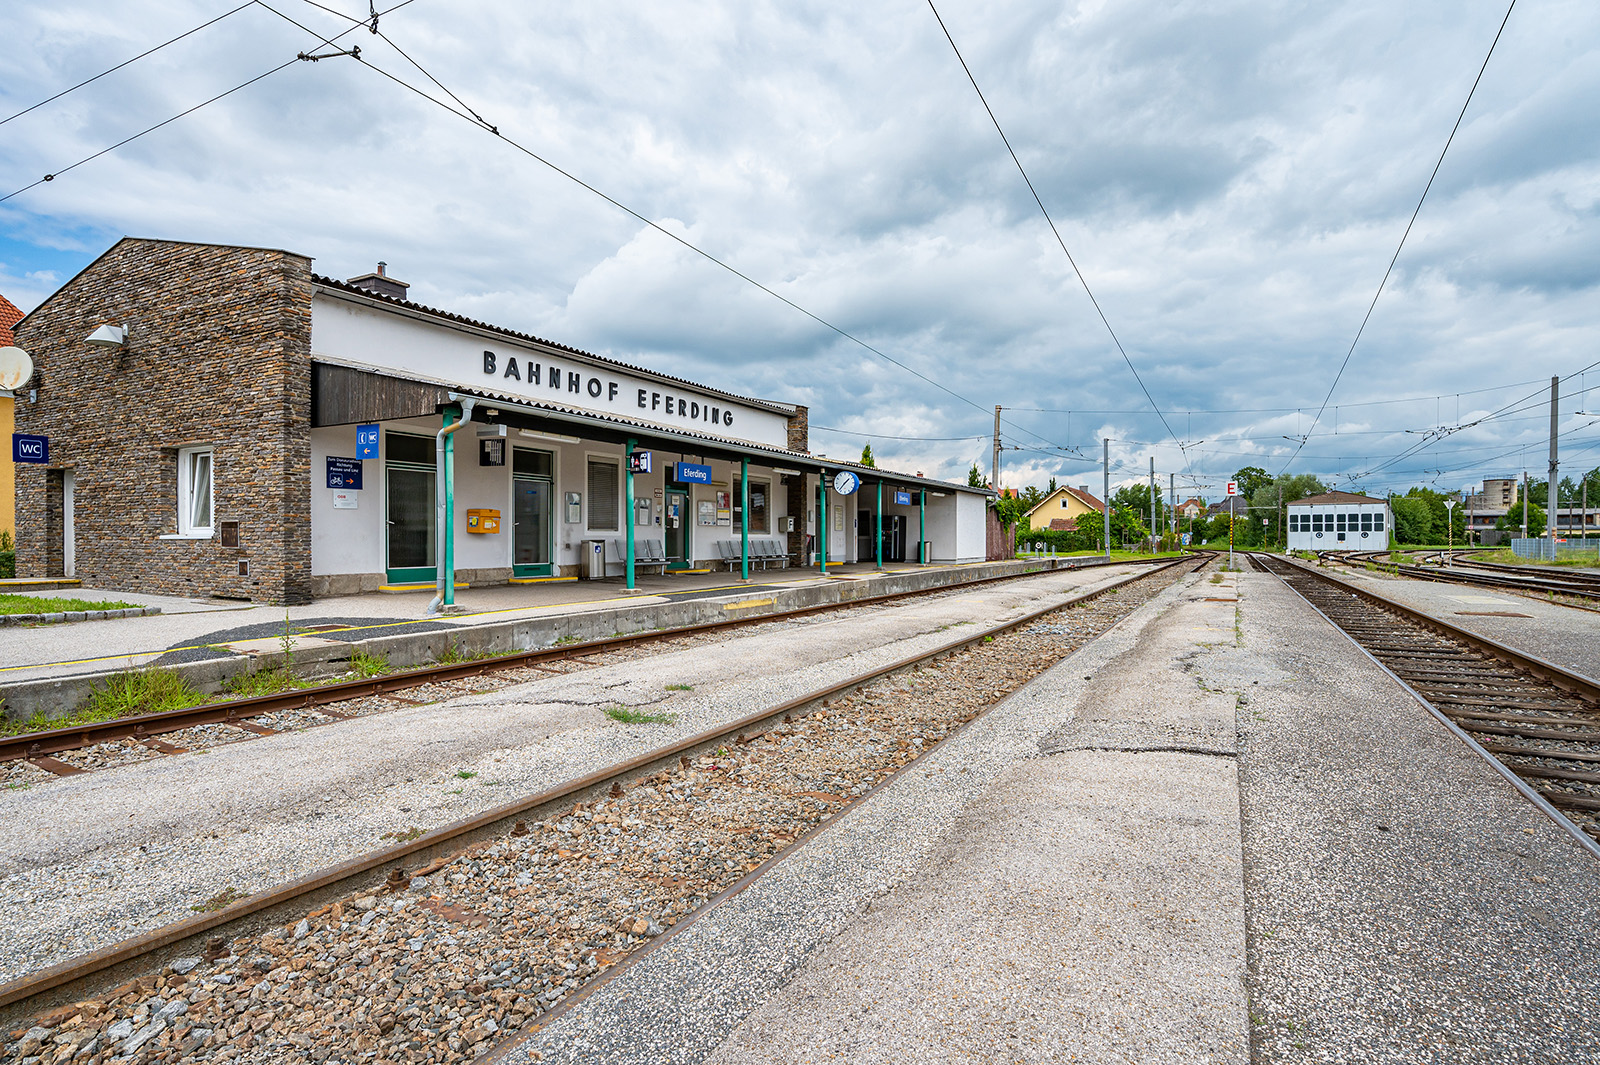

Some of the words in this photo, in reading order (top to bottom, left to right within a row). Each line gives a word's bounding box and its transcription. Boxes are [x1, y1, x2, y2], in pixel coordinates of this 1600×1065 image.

[483, 350, 619, 401] BAHNHOF
[637, 388, 734, 427] EFERDING
[21, 443, 41, 454] WC
[683, 467, 707, 481] Eferding
[1227, 482, 1236, 494] E
